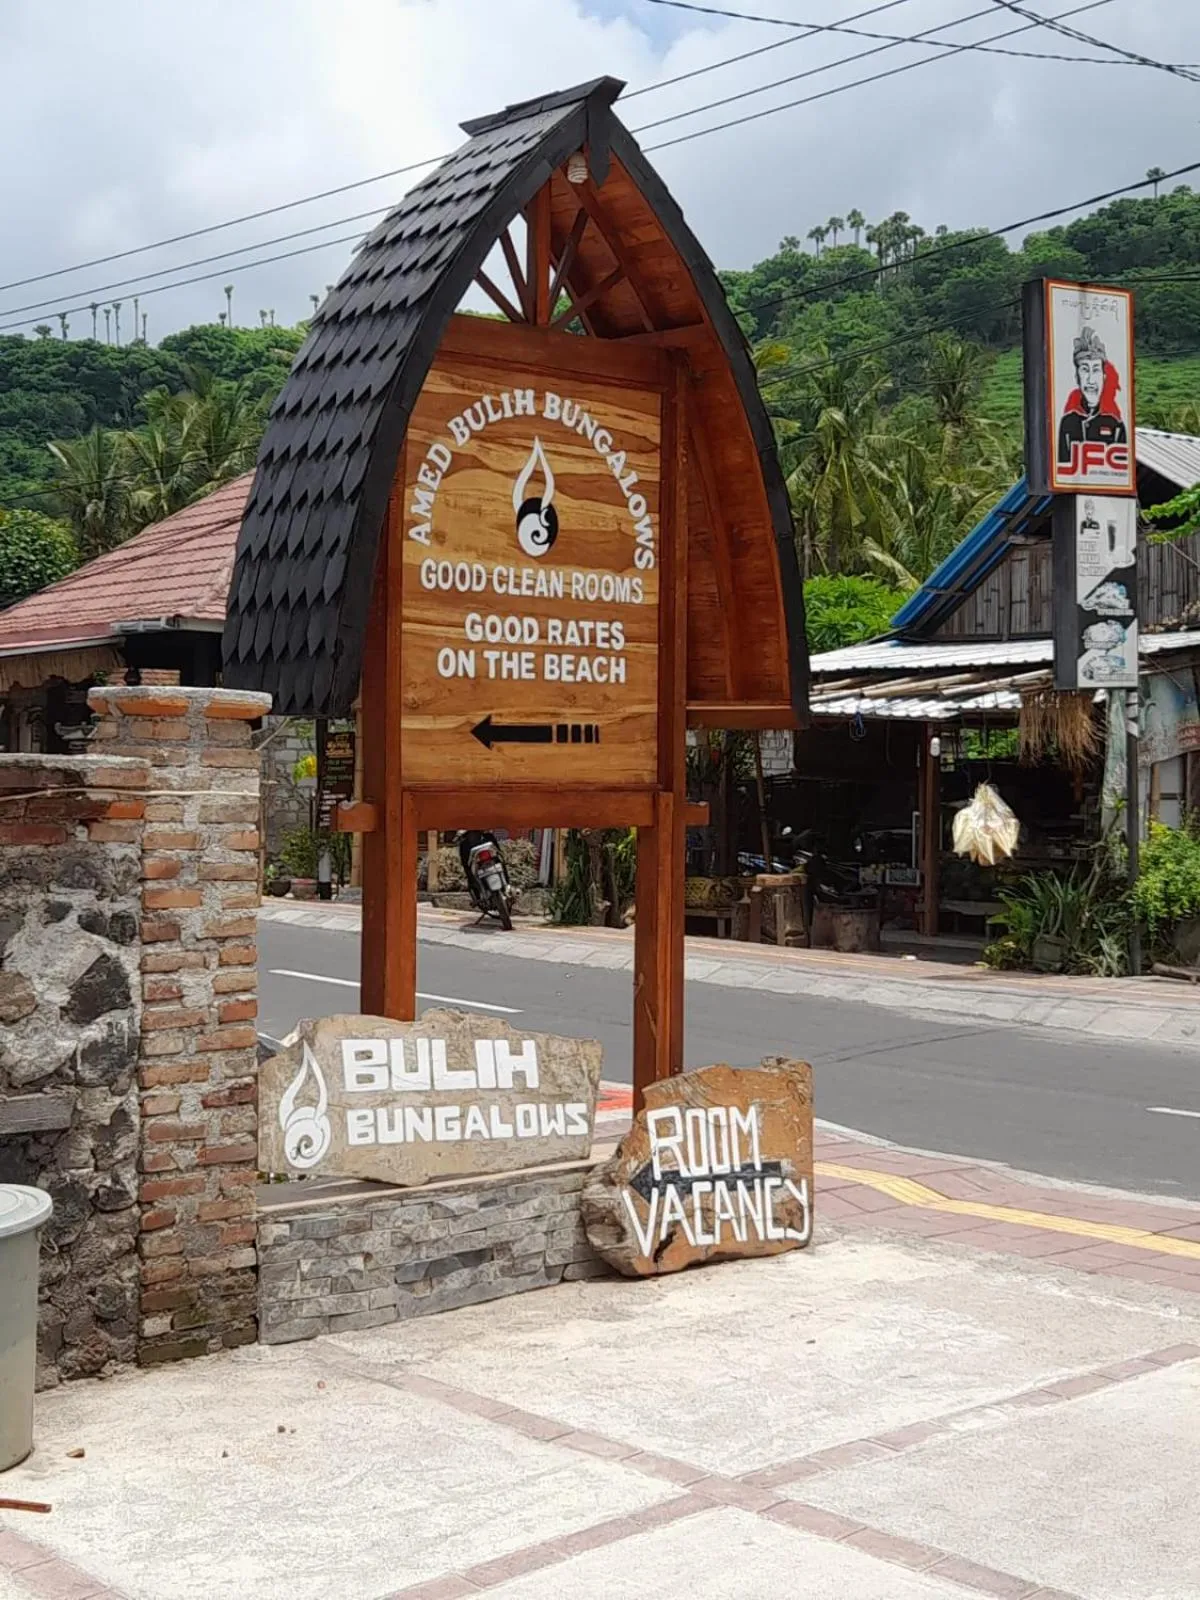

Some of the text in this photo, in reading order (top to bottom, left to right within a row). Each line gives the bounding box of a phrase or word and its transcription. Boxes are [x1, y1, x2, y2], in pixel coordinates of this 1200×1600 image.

[408, 388, 655, 570] AMED BULIH BUNGALOWS
[1057, 443, 1129, 476] JFC
[420, 558, 644, 605] GOOD CLEAN ROOMS
[464, 612, 625, 651] GOOD RATES
[437, 647, 626, 684] ON THE BEACH
[341, 1038, 539, 1093] BULIH
[346, 1103, 589, 1146] BUNGALOWS
[646, 1104, 762, 1181] ROOM
[622, 1178, 810, 1258] VACANCY
